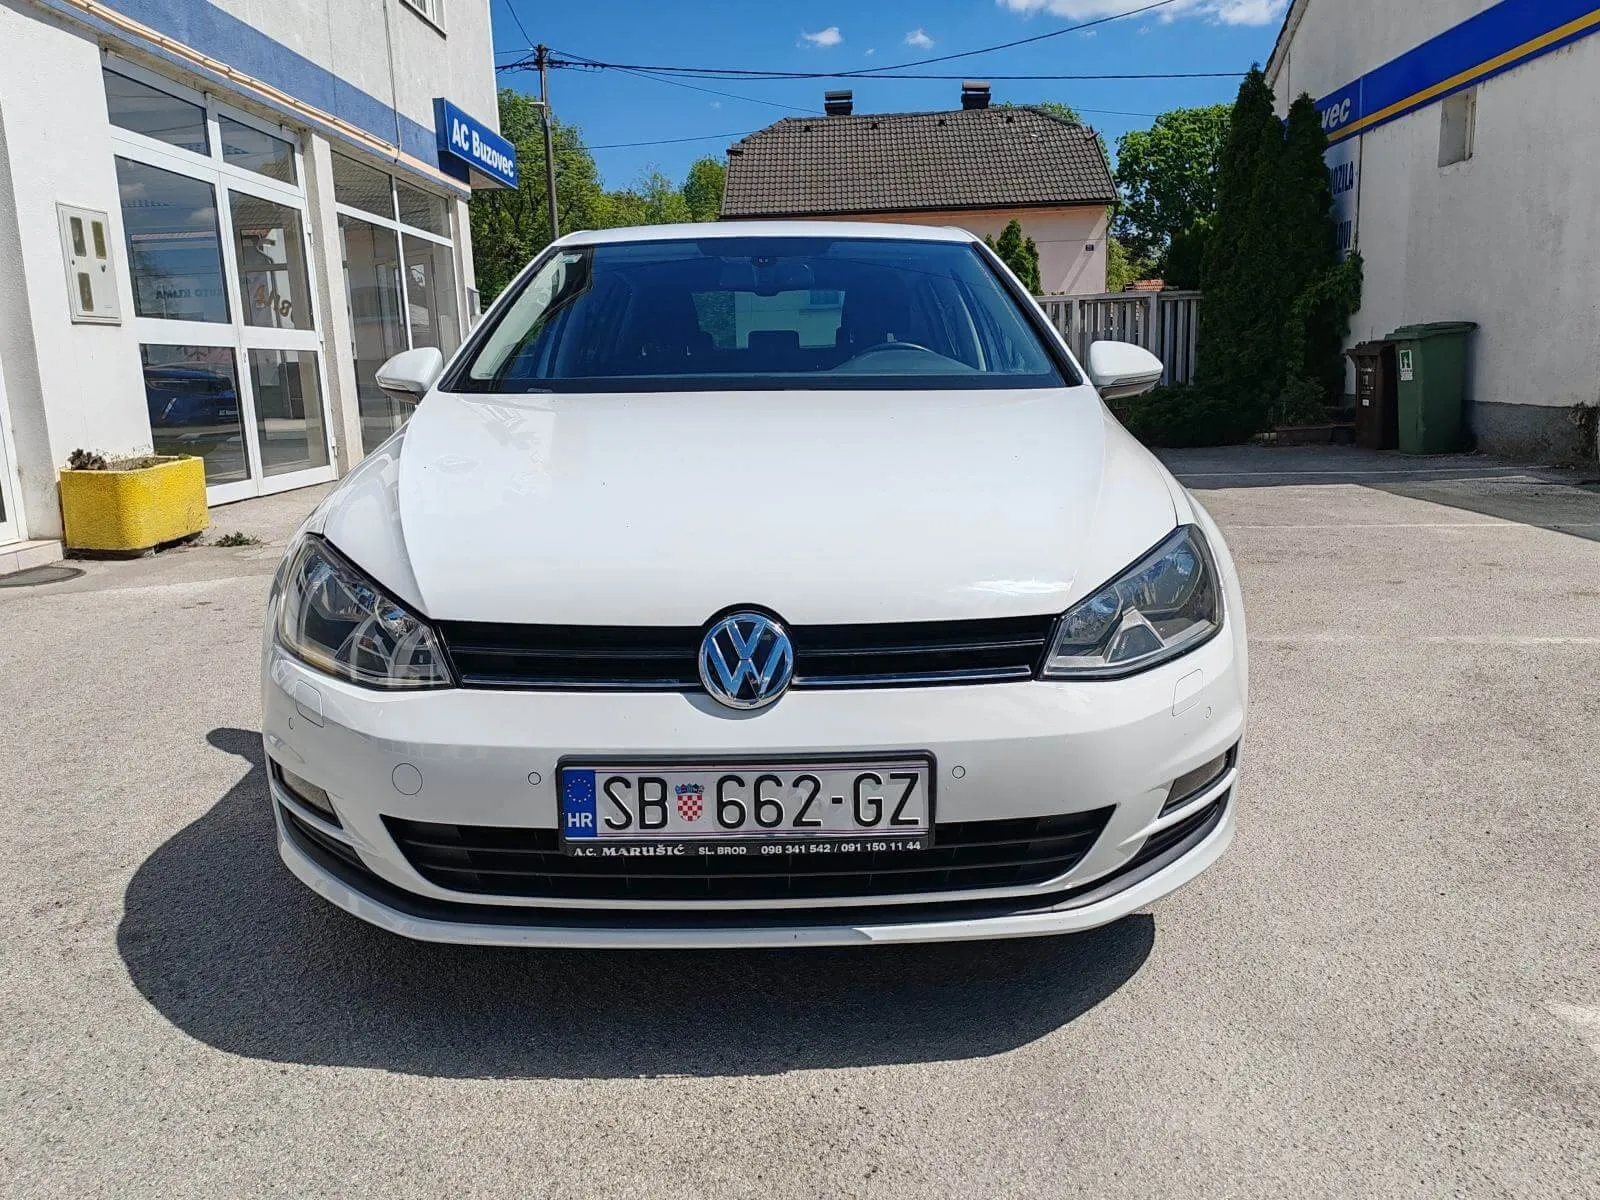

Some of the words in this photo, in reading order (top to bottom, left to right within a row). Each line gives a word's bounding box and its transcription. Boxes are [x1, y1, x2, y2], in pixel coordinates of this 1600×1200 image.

[1321, 97, 1351, 129] vec
[452, 118, 470, 152] AC
[472, 130, 514, 178] Buzovec
[603, 775, 669, 830] SB
[716, 771, 921, 830] 662-GZ
[567, 812, 593, 828] HR
[574, 847, 597, 857] A.C.
[602, 844, 685, 857] MARUŠIĆ
[698, 846, 714, 856] SL.
[717, 846, 747, 855] BROD
[761, 845, 782, 855] 098
[785, 844, 806, 854] 341
[809, 844, 831, 853] 542
[841, 843, 861, 852] 091
[866, 842, 886, 852] 150
[889, 841, 902, 851] 11
[906, 841, 921, 851] 44
